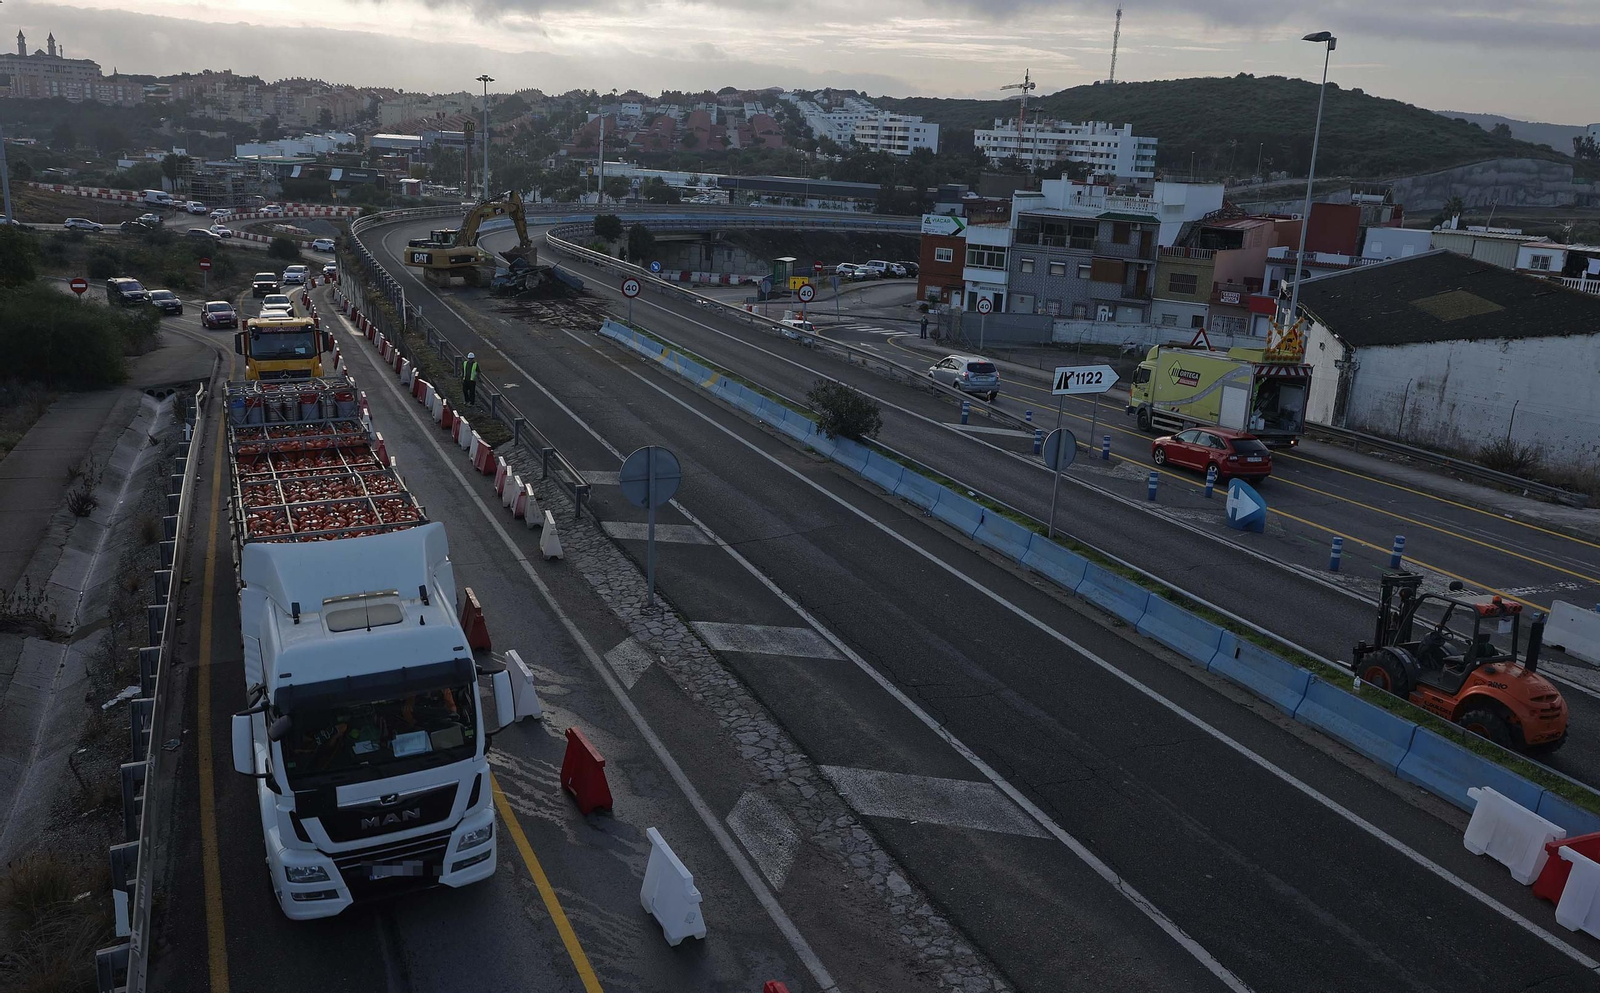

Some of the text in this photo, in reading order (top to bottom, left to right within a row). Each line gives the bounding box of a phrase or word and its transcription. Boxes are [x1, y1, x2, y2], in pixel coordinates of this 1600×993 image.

[414, 253, 428, 264] CAT
[625, 284, 637, 292] 40
[1075, 371, 1103, 385] 1122
[1179, 370, 1199, 380] ORTEGA
[1487, 680, 1508, 690] RINO
[361, 807, 420, 830] MAN
